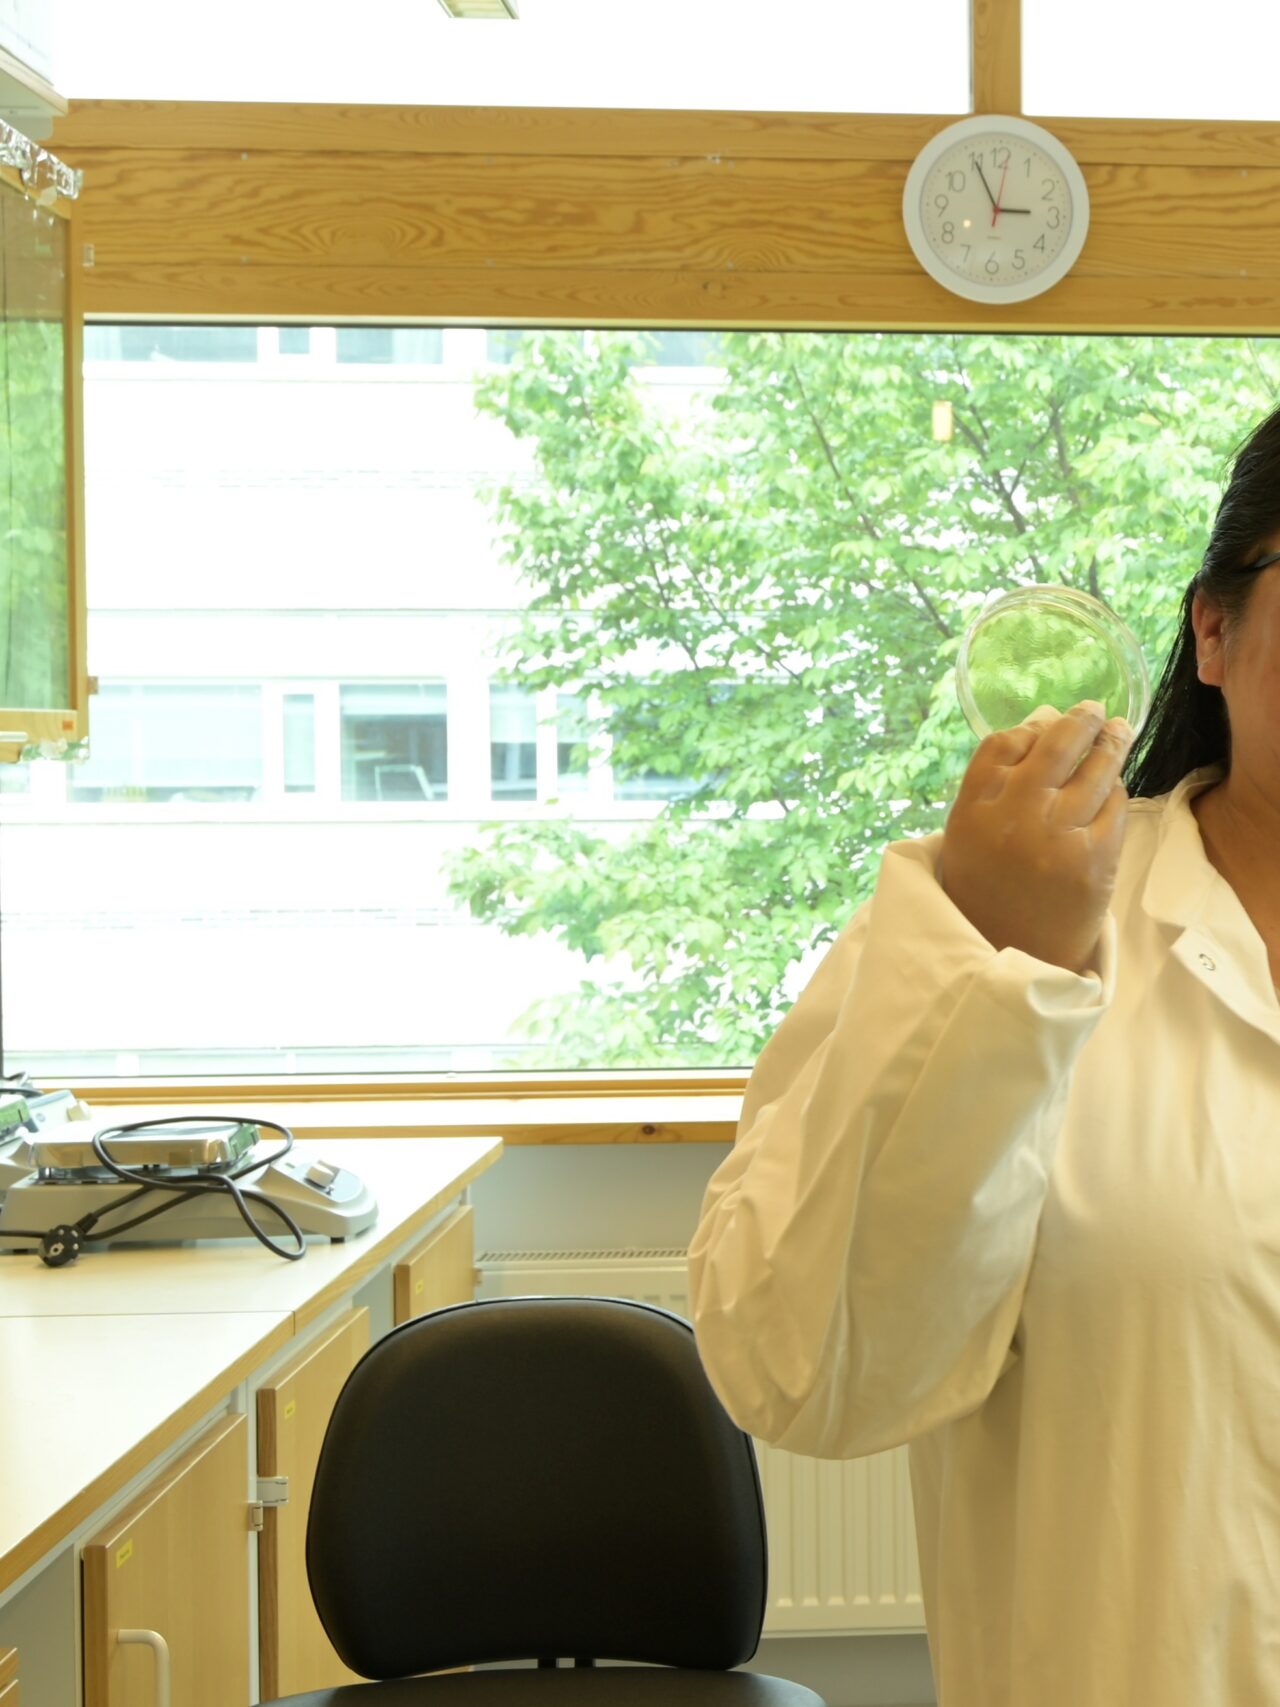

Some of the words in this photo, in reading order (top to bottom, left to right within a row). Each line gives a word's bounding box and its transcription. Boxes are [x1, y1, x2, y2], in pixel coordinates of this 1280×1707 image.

[968, 151, 985, 173] 11
[990, 146, 1012, 170] 12
[1023, 157, 1032, 178] 1
[945, 169, 966, 193] 10
[1041, 178, 1057, 201] 2
[934, 193, 949, 217] 9
[1046, 206, 1061, 230] 3
[941, 221, 955, 245] 8
[1032, 233, 1046, 254] 4
[960, 242, 972, 263] 7
[984, 251, 1000, 275] 6
[1011, 249, 1026, 270] 5
